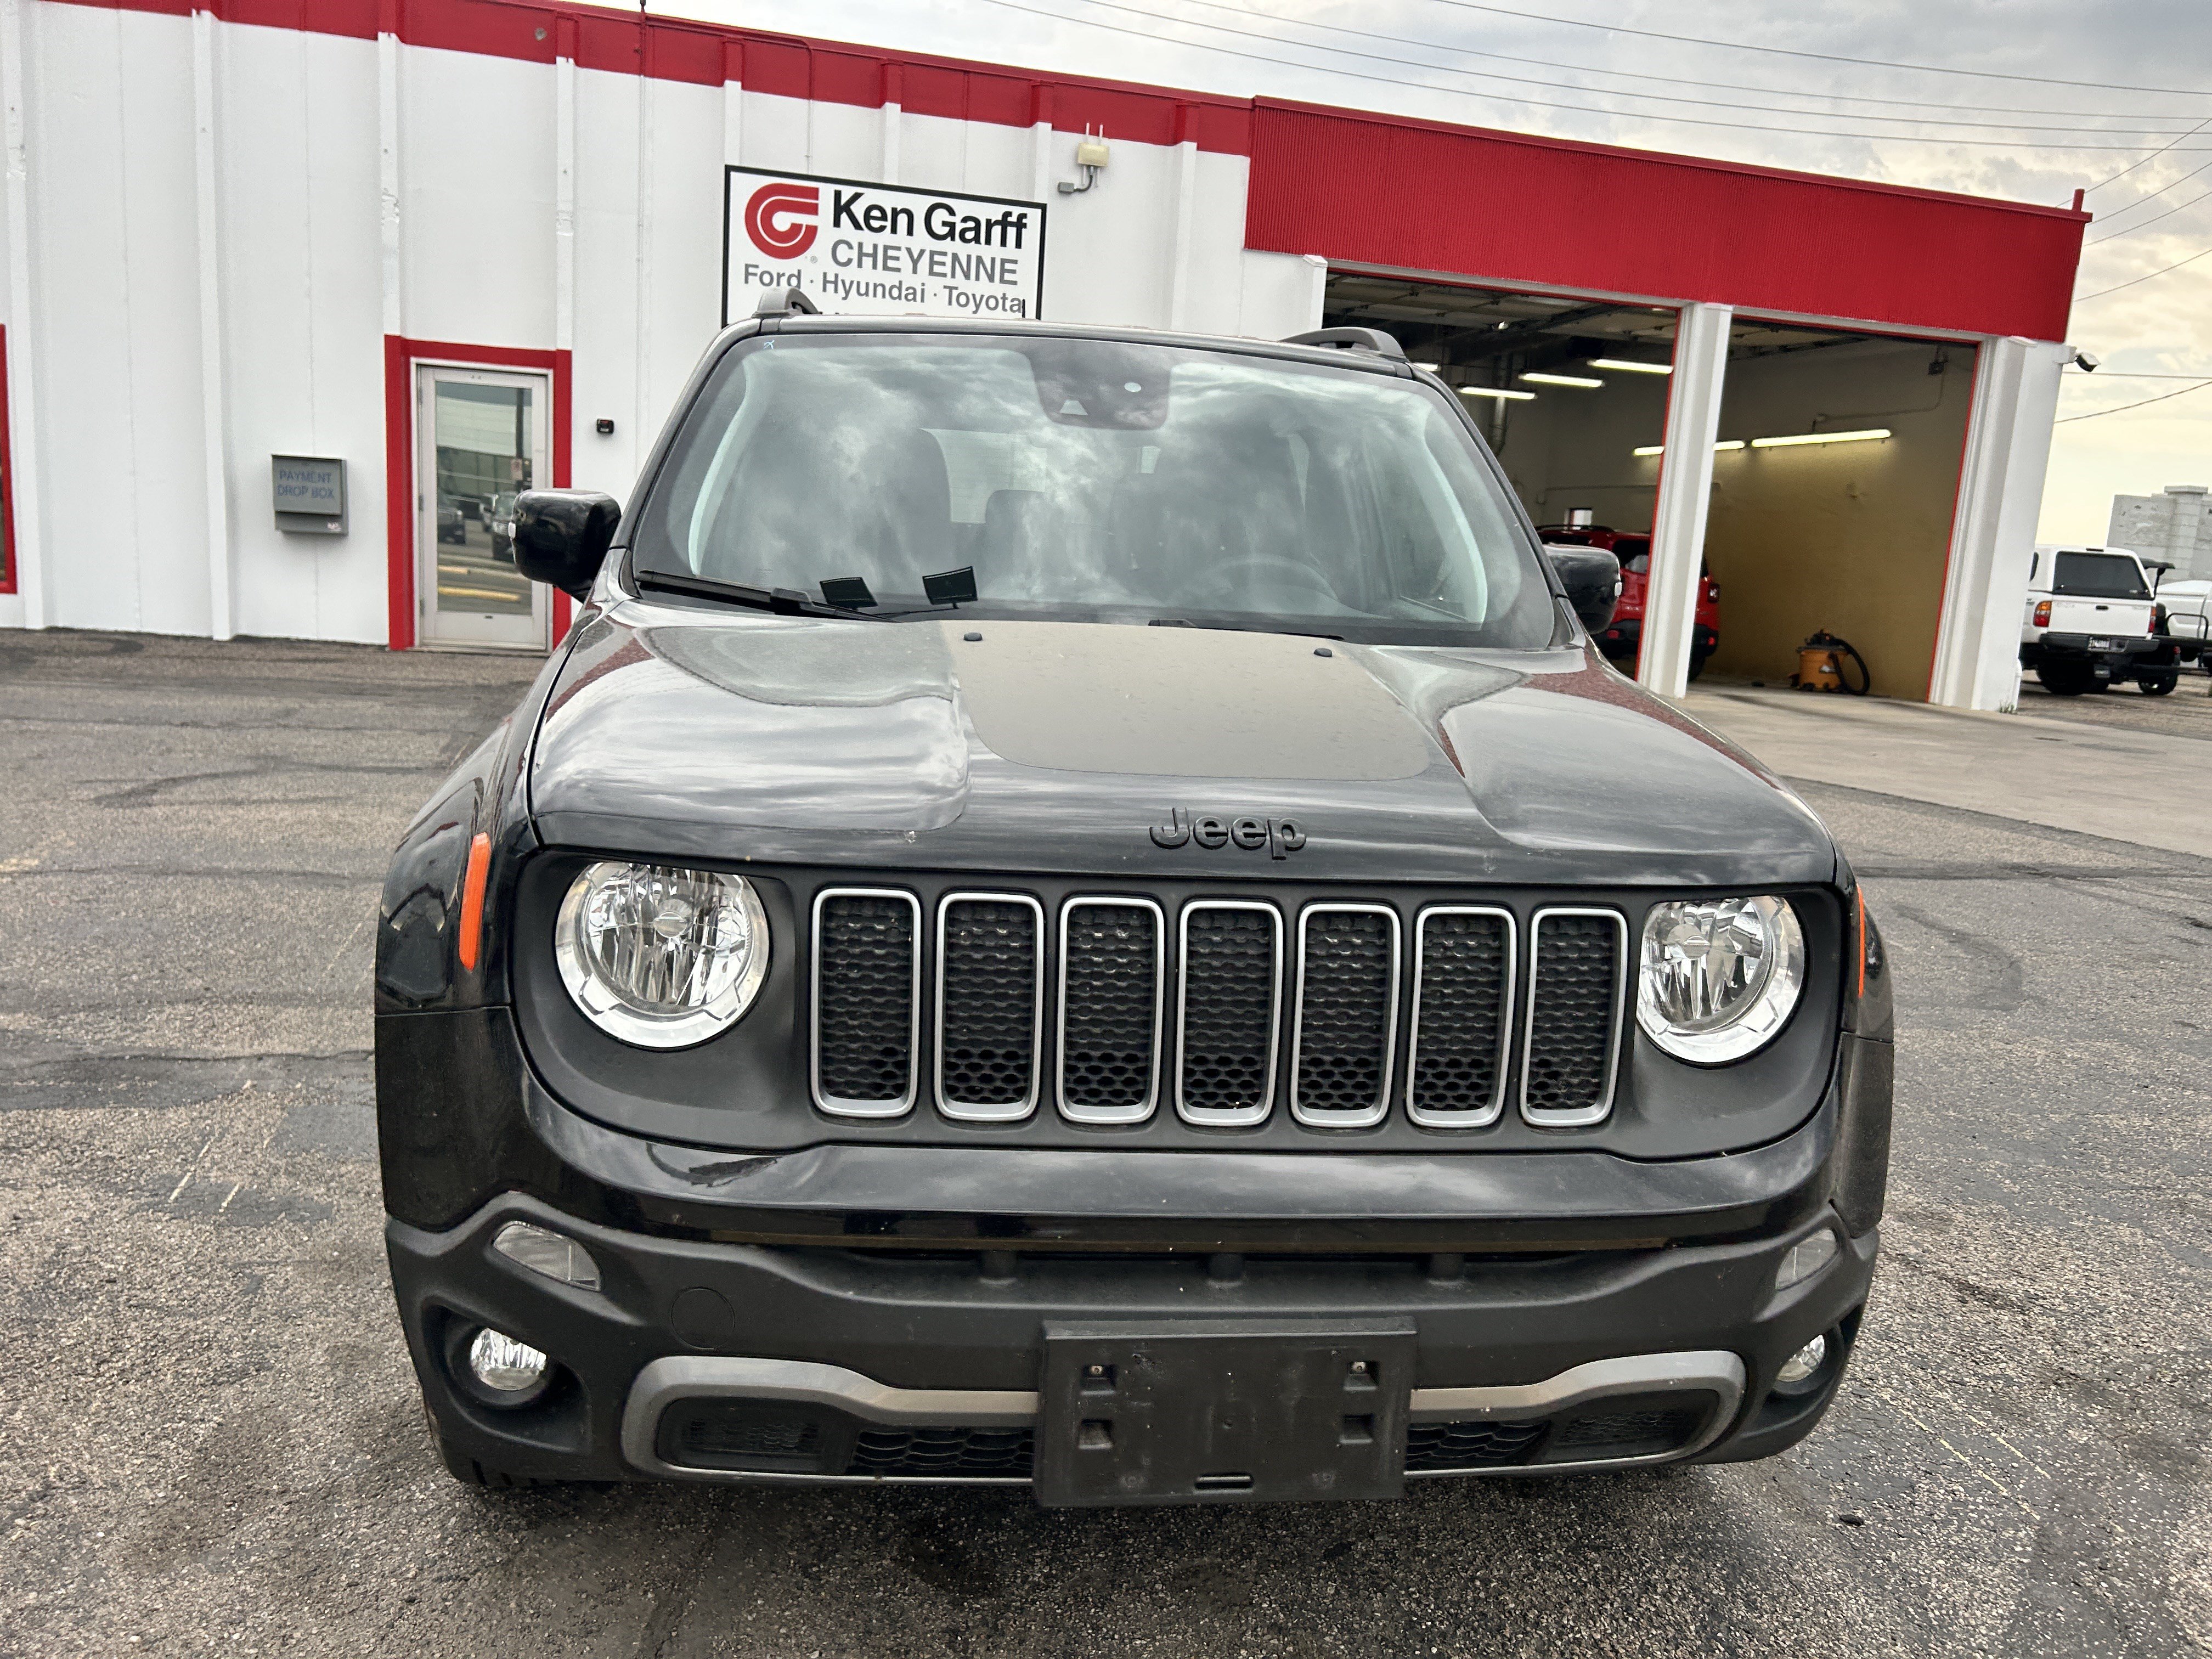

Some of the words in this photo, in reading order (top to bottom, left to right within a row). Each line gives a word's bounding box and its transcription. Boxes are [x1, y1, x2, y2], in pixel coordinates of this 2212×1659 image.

[833, 189, 914, 236] Ken
[924, 202, 1027, 249] Garff
[831, 239, 1018, 286] CHEYENNE
[744, 263, 802, 289] Ford
[822, 272, 926, 303] Hyundai
[943, 285, 1023, 314] Toyota
[278, 484, 308, 496] DROP
[311, 487, 334, 499] BOX
[279, 470, 332, 483] PAYMENT
[1149, 807, 1307, 860] Jeep
